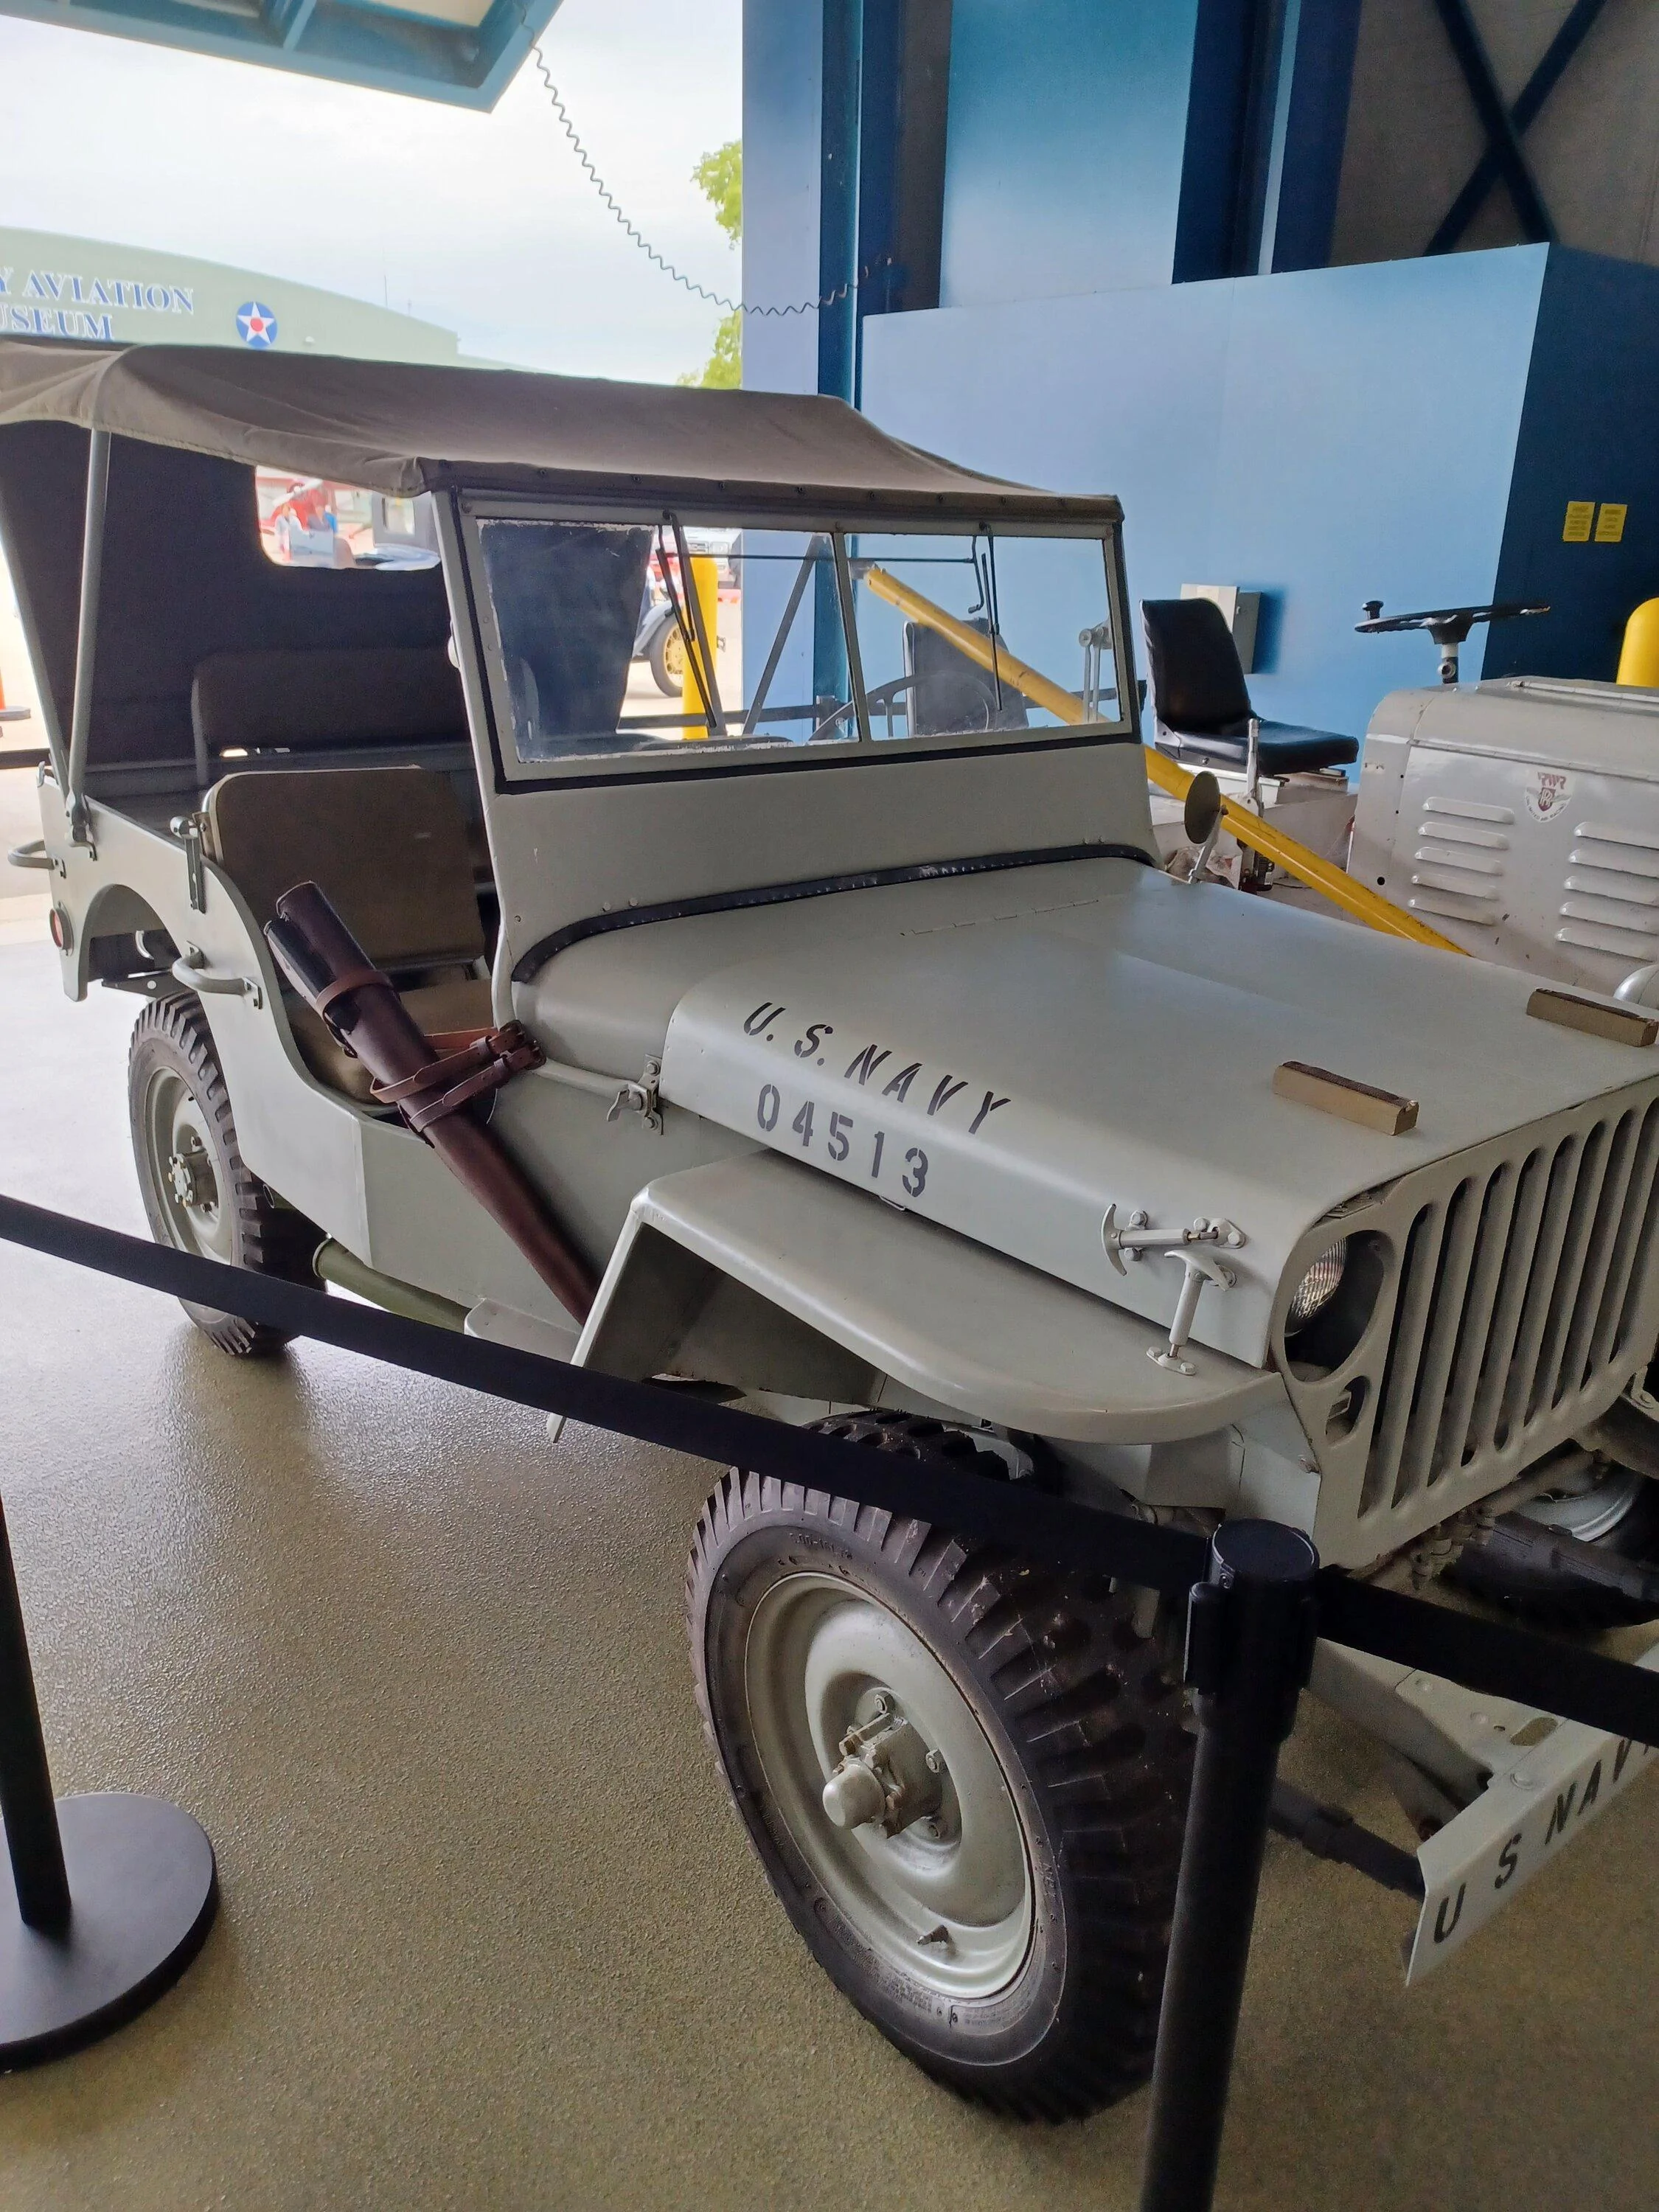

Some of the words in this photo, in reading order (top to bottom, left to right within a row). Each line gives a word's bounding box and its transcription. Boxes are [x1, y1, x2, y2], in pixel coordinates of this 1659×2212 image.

[21, 269, 195, 316] AVIATION
[757, 1083, 929, 1198] 04513
[844, 1043, 1012, 1135] NAVY
[1433, 1882, 1467, 1944] U
[1495, 1832, 1522, 1890] S
[1545, 1739, 1649, 1845] NAV
